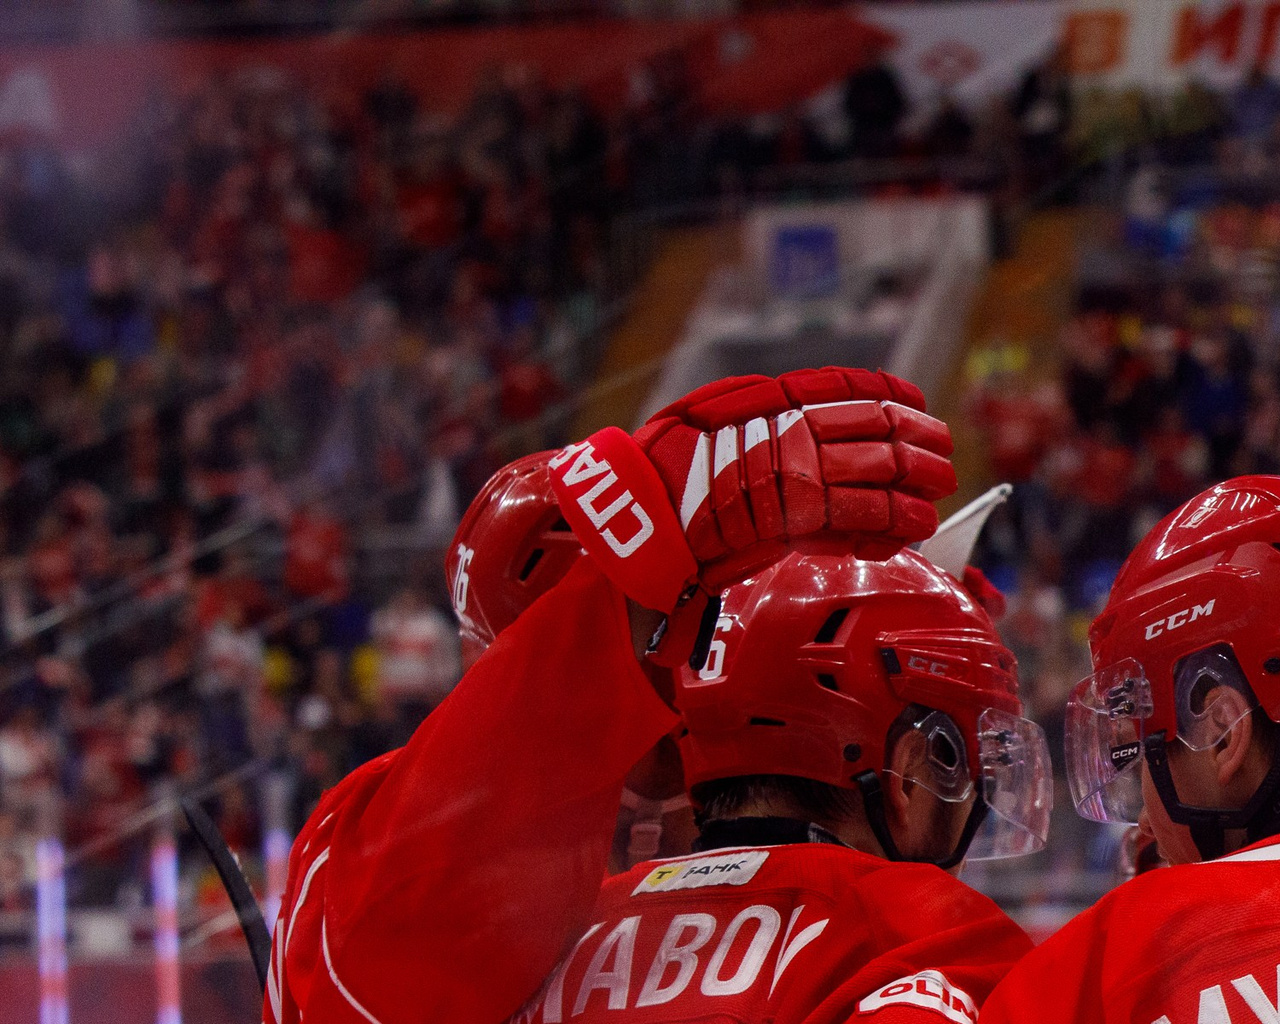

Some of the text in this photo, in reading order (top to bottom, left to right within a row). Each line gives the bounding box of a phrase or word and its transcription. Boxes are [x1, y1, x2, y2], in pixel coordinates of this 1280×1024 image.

[1144, 598, 1217, 641] CCM
[698, 616, 734, 681] 6
[1112, 746, 1138, 760] CCM
